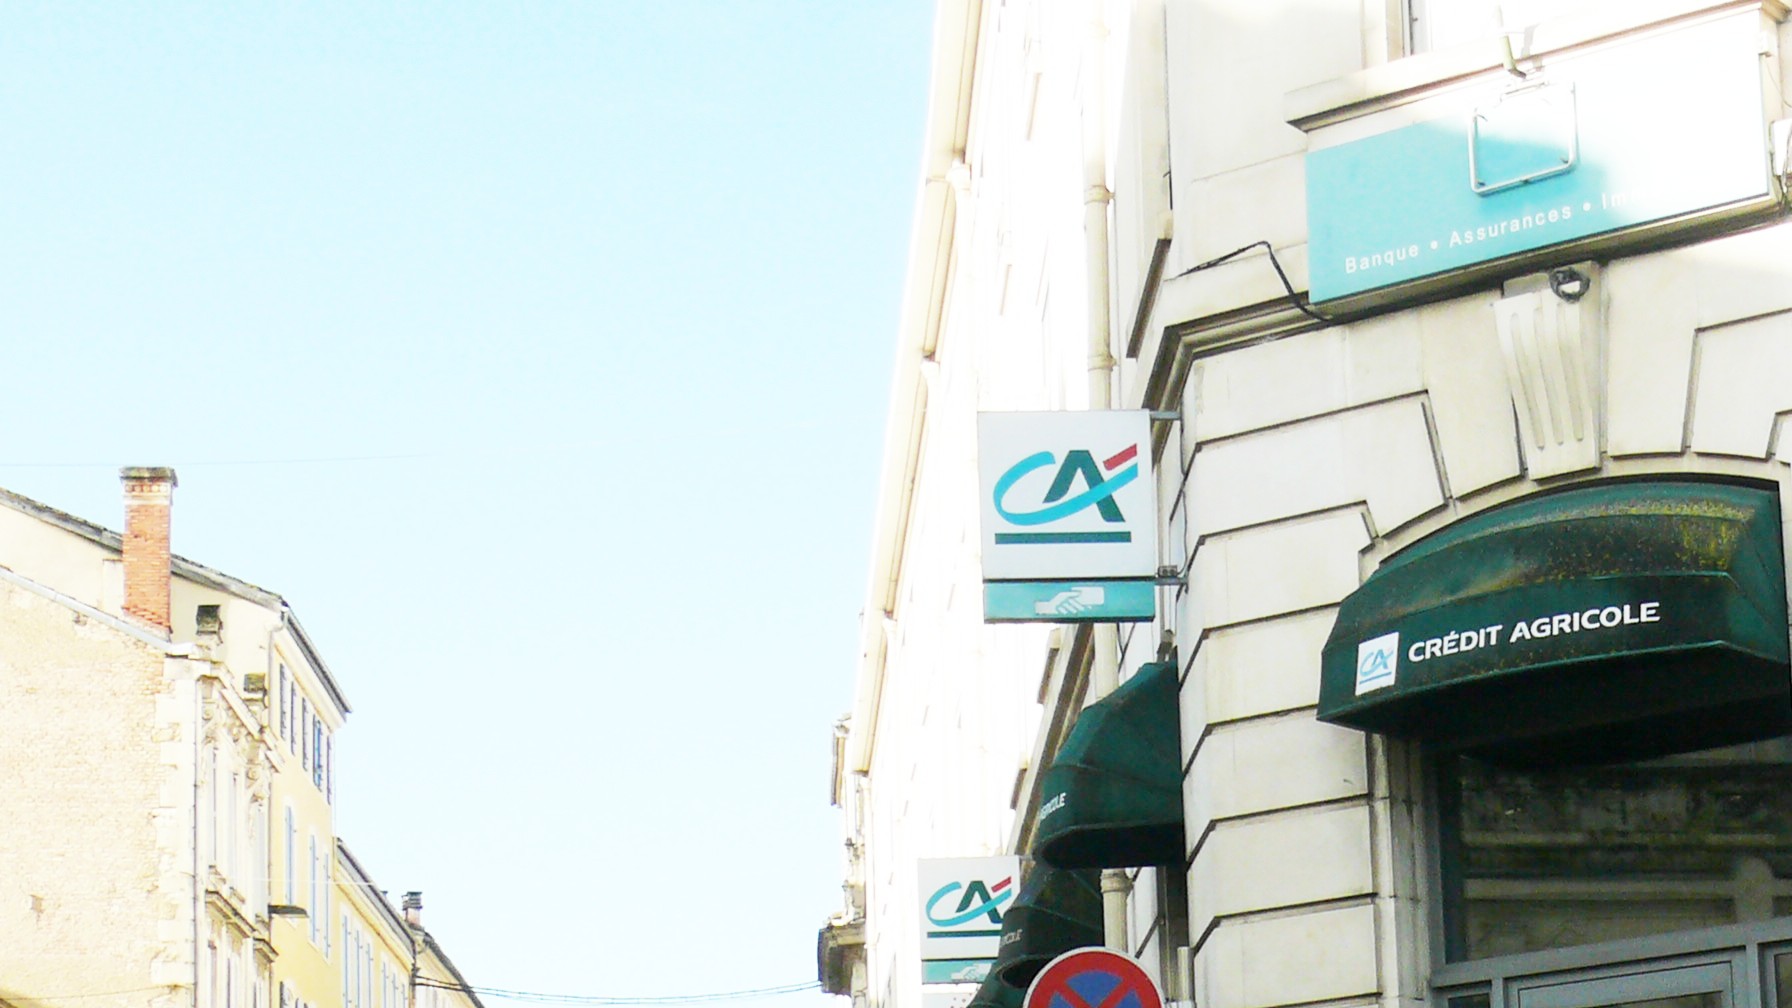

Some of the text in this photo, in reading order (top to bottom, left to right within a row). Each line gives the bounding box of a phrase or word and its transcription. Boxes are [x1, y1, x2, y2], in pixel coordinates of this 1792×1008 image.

[1345, 243, 1419, 274] Banque
[1449, 204, 1572, 248] Assurances
[992, 442, 1138, 526] CA
[1408, 602, 1661, 663] CRÉDIT AGRICOLE
[925, 875, 1012, 927] CA
